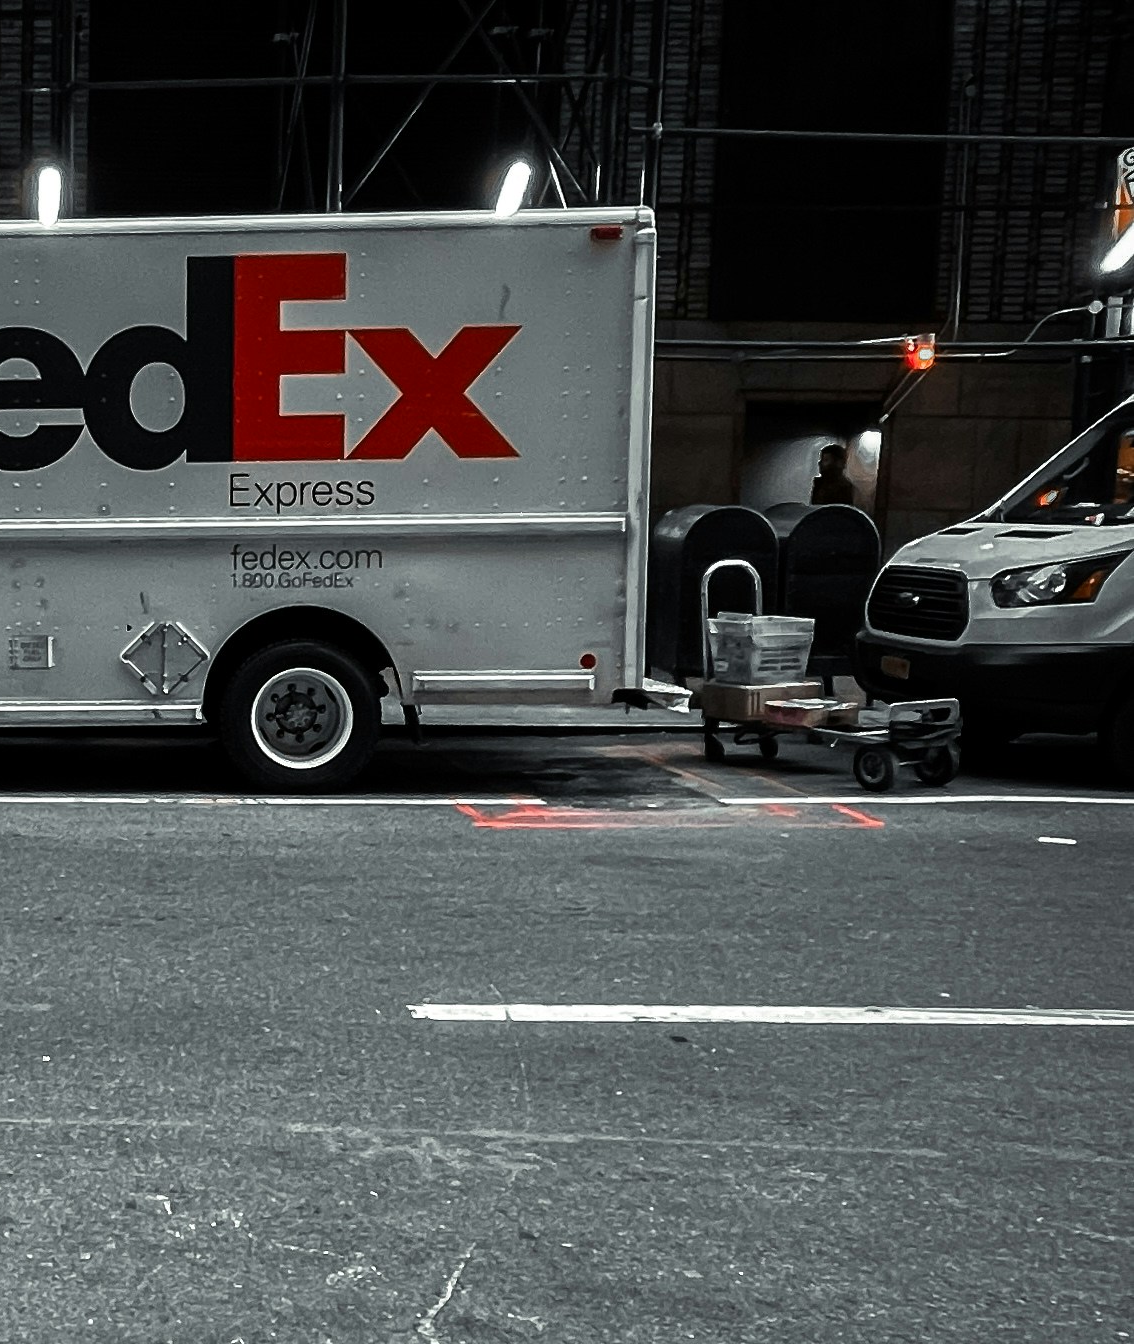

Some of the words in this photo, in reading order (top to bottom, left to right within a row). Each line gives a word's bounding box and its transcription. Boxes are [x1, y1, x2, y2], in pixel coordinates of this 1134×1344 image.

[229, 473, 375, 514] Express
[230, 544, 383, 570] fedex.com
[230, 571, 354, 588] 1.800.GoFedEx
